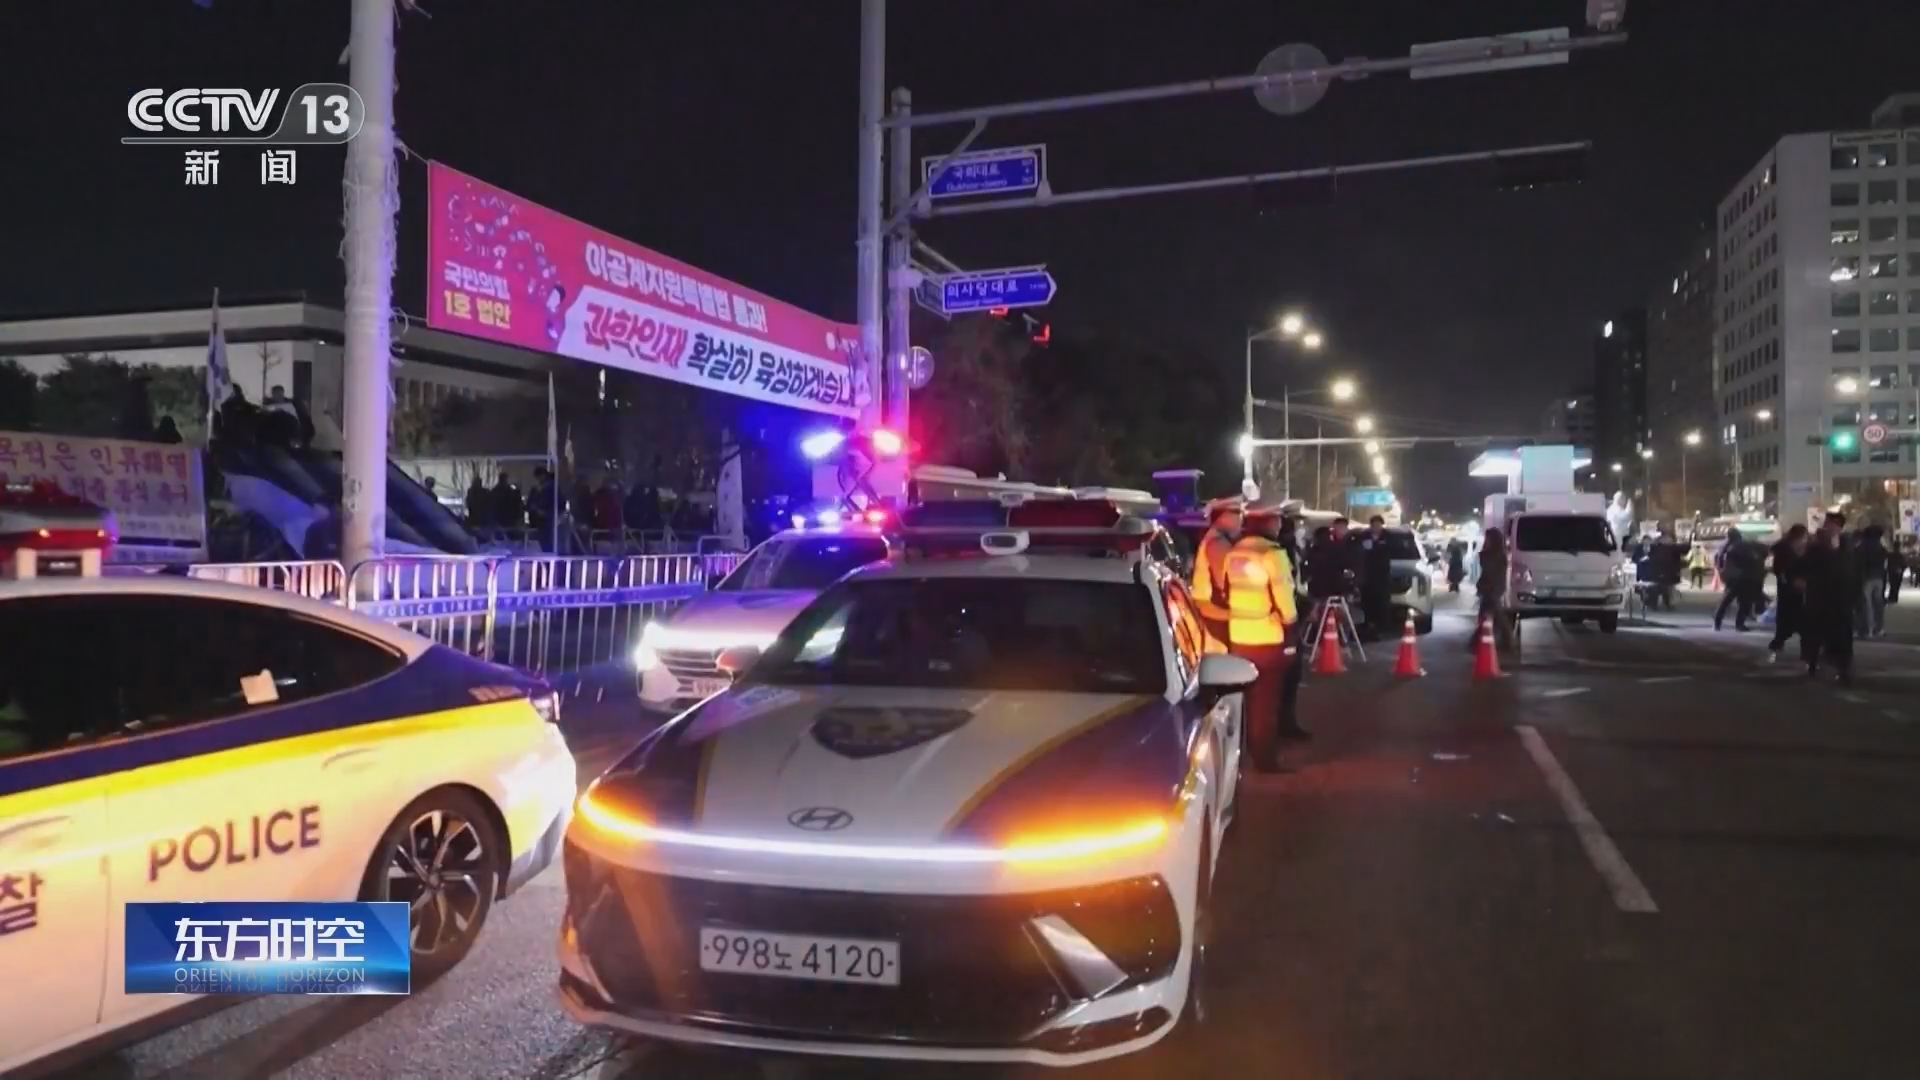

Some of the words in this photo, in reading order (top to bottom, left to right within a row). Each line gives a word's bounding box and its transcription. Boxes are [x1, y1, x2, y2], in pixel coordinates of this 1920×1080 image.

[952, 163, 1000, 180] 국회대로
[444, 289, 472, 320] 1호
[476, 297, 511, 329] 법안
[947, 279, 1019, 298] 의사당대로
[584, 302, 688, 368] 과학인재
[686, 332, 753, 384] 확실히
[147, 805, 321, 882] POLICE
[711, 934, 793, 971] 998노
[801, 942, 885, 978] 4120
